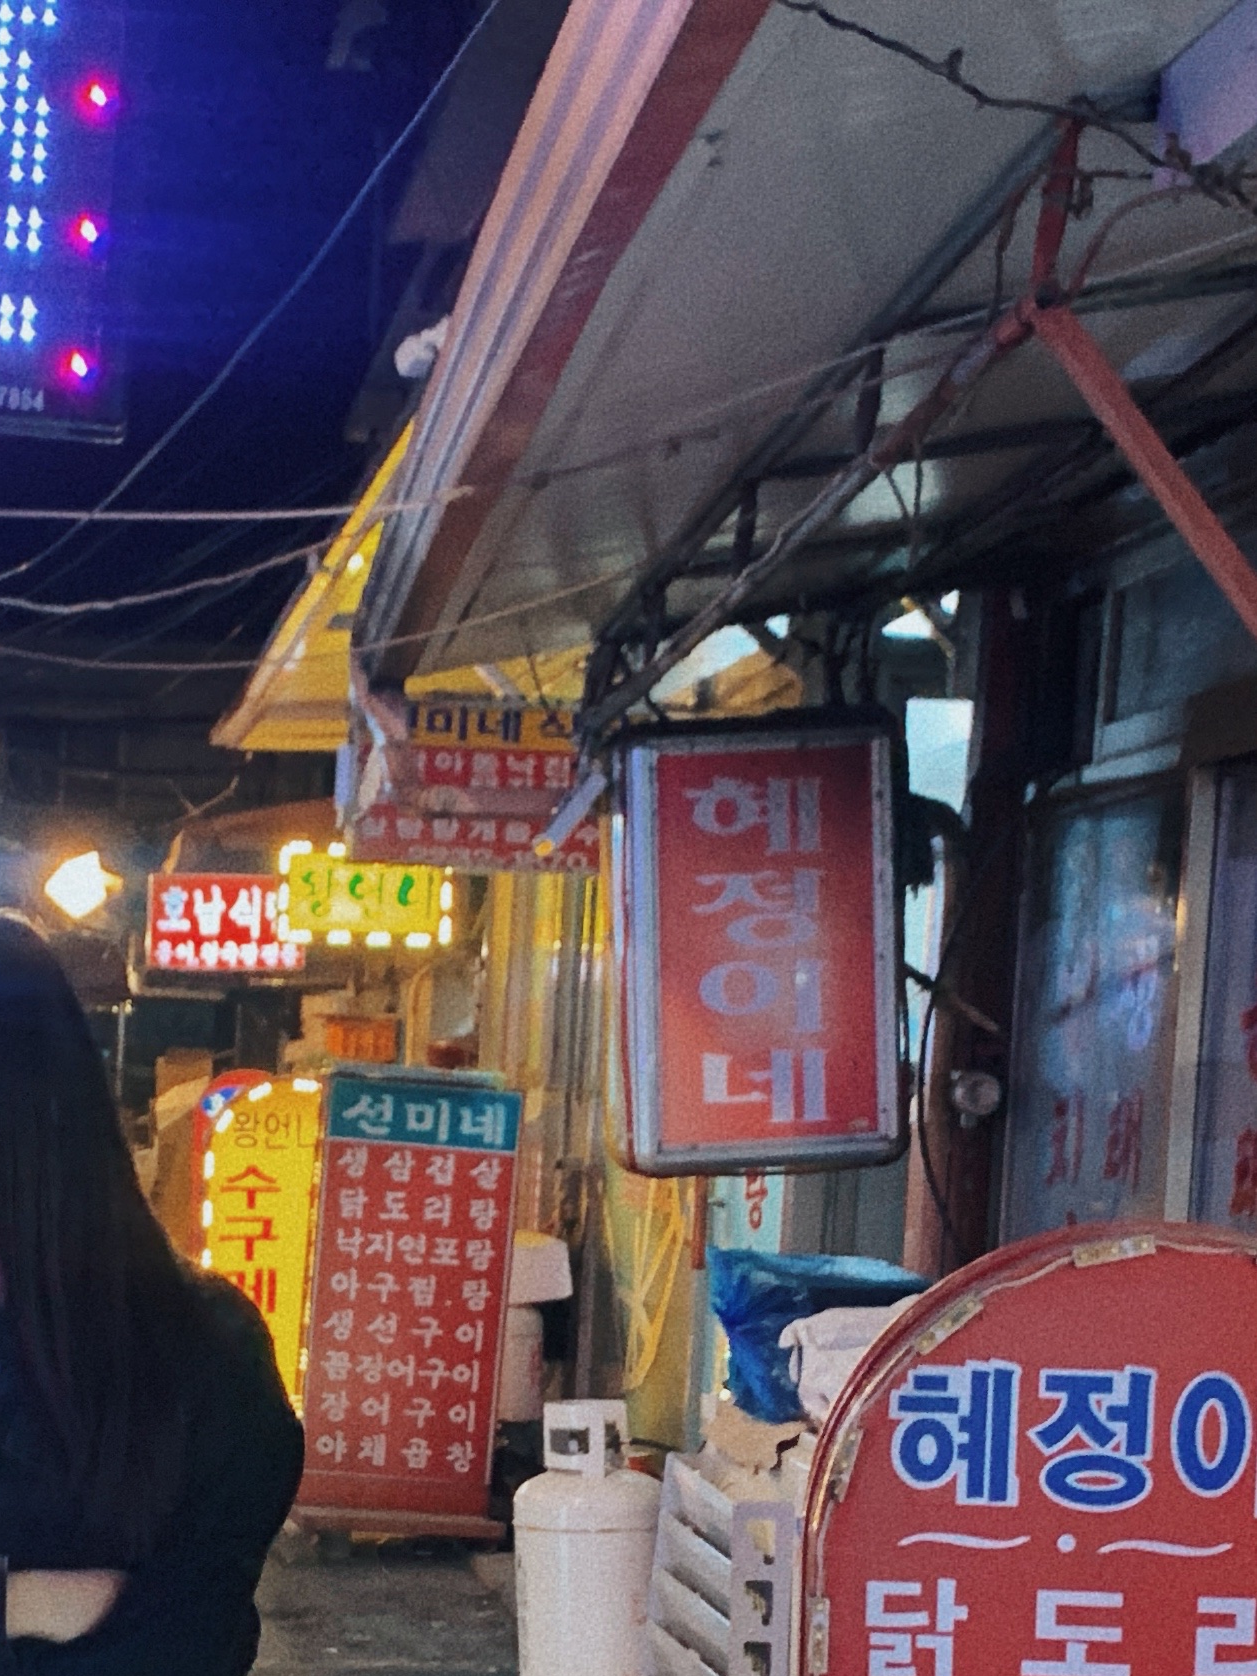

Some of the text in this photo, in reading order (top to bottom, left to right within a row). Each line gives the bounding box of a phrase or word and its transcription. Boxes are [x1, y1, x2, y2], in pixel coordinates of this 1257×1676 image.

[683, 775, 829, 1124] 혜정이네
[342, 1094, 506, 1145] 선미네
[322, 1308, 484, 1352] 생선구이
[321, 1390, 475, 1432] 장어구이
